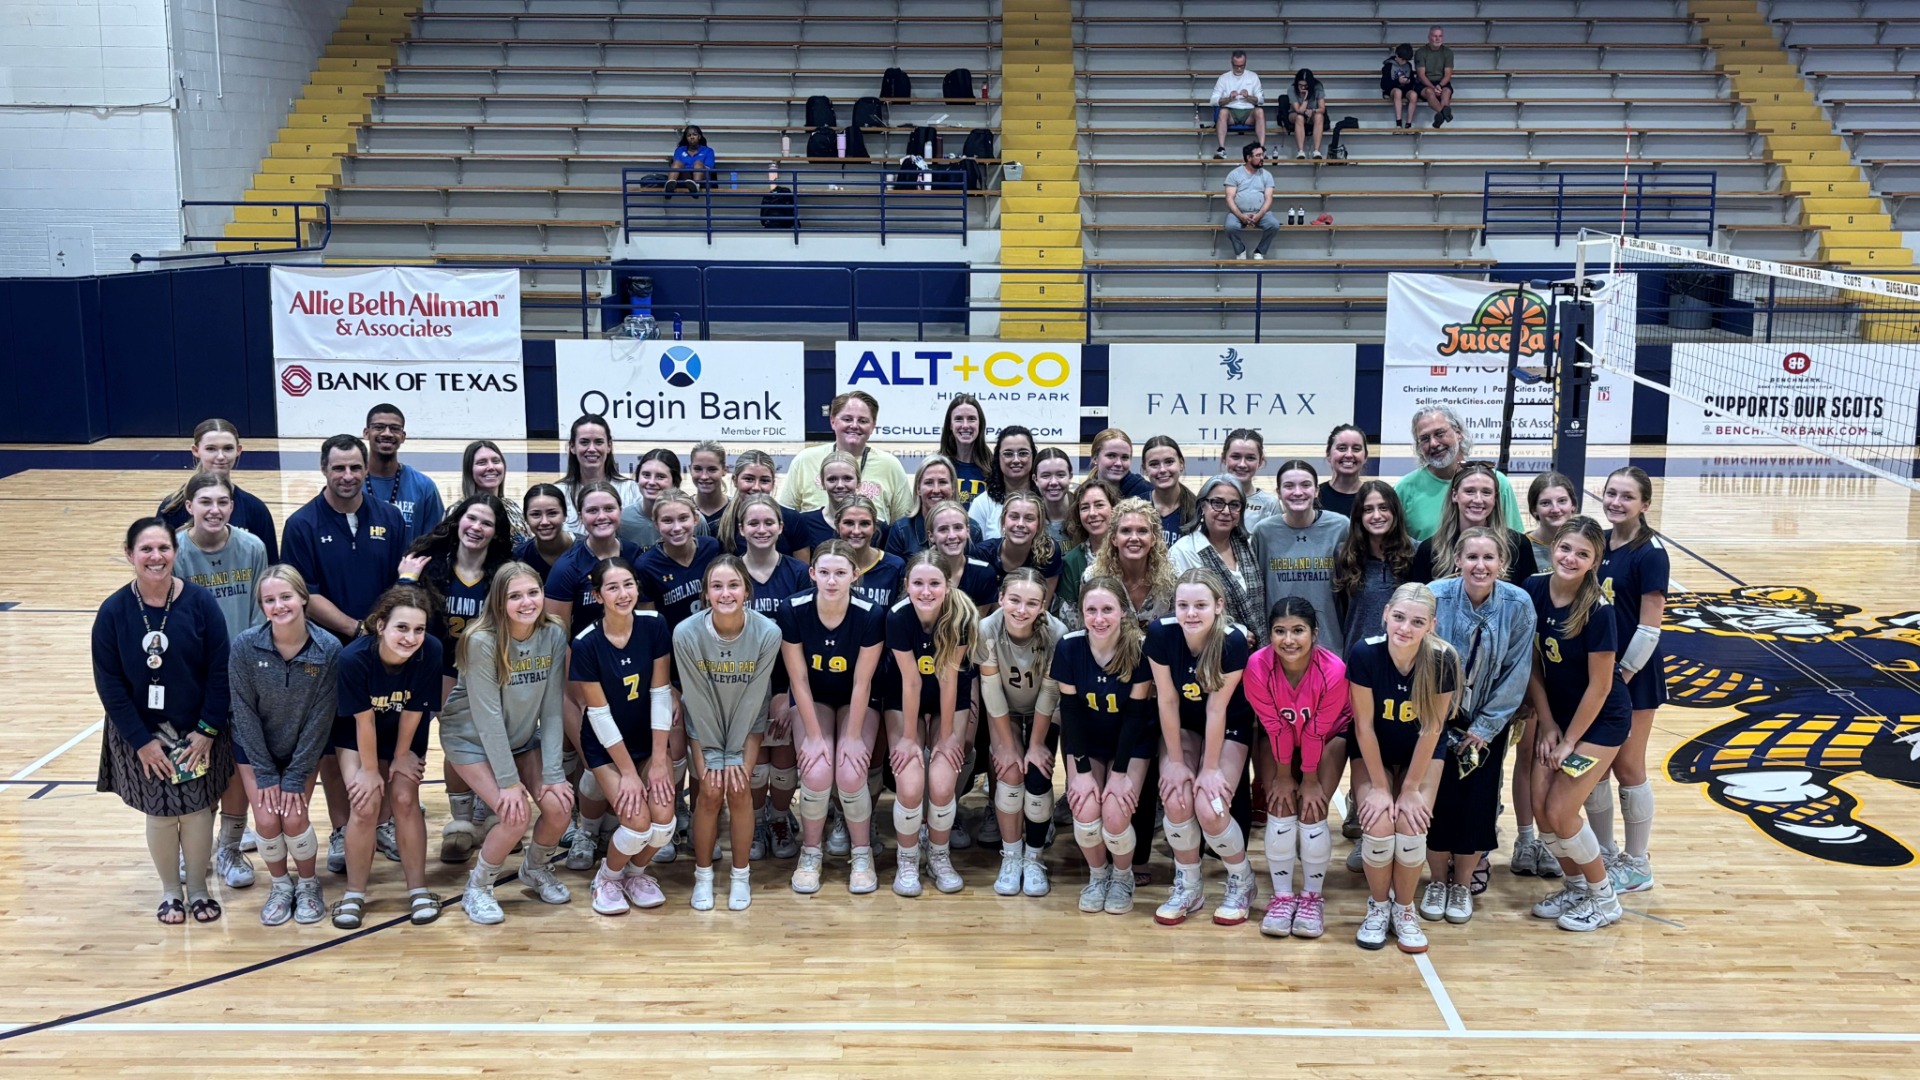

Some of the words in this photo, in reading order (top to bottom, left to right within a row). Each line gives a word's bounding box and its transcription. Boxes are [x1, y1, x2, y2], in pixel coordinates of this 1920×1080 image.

[1034, 39, 1040, 47] K
[1035, 65, 1040, 73] J
[1758, 66, 1763, 74] J
[1036, 93, 1041, 101] H
[322, 115, 327, 123] G
[1791, 122, 1796, 130] G
[1809, 152, 1815, 160] F
[290, 176, 295, 184] E
[1037, 183, 1042, 191] E
[1828, 184, 1834, 192] E
[1038, 215, 1044, 223] D
[1848, 216, 1853, 224] D
[1039, 250, 1044, 258] C
[1868, 251, 1875, 259] C
[1696, 249, 1717, 262] HIGHLAND
[1718, 254, 1730, 265] PARK
[1746, 259, 1761, 271] SCOTS
[1780, 264, 1806, 279] HIGHLAND
[1806, 269, 1822, 281] PARK
[1843, 275, 1862, 288] SCOTS
[1886, 281, 1919, 297] HIGHLAND
[1039, 286, 1045, 294] B
[289, 290, 344, 315] Allie
[349, 291, 405, 316] Beth
[336, 318, 352, 336] &
[355, 318, 453, 337] Associates
[1040, 324, 1045, 333] A
[1440, 325, 1560, 355] JuiceLa
[847, 351, 1071, 388] ALT+CO
[317, 371, 390, 391] BANK
[396, 372, 427, 391] OF
[435, 372, 518, 392] TEXAS
[1402, 385, 1438, 393] Christine
[1440, 385, 1478, 394] McKenny
[1492, 385, 1508, 393] Par
[1514, 385, 1536, 393] Cities
[1027, 392, 1070, 401] PARK
[580, 390, 686, 428] Origin
[700, 391, 782, 421] Bank
[1147, 393, 1316, 416] FAIRFAX
[1704, 395, 1789, 418] SUPPORTS
[1794, 396, 1826, 418] OUR
[1831, 396, 1884, 418] SCOTS
[721, 427, 761, 436] Member
[763, 427, 787, 436] FDIC
[1198, 427, 1262, 441] TIT
[1715, 425, 1868, 436] BENCHRKBANK.COM
[369, 525, 387, 537] HP
[1269, 557, 1311, 570] HIGHLAND
[1313, 557, 1334, 569] PARK
[1276, 571, 1330, 582] VOLLEYBALL
[663, 579, 703, 606] HIGHLAND
[868, 587, 892, 606] PARK
[535, 655, 552, 670] PAR
[697, 660, 735, 673] HIHLAND
[738, 661, 755, 673] PAR
[811, 654, 848, 673] 19
[918, 655, 935, 675] 6
[508, 670, 549, 686] LLEYBAL
[707, 673, 752, 684] LEYBALL
[1009, 666, 1034, 689] 21
[623, 673, 640, 701] 7
[1182, 682, 1203, 701] 2
[1086, 692, 1119, 713] 11
[1382, 698, 1418, 722] 16
